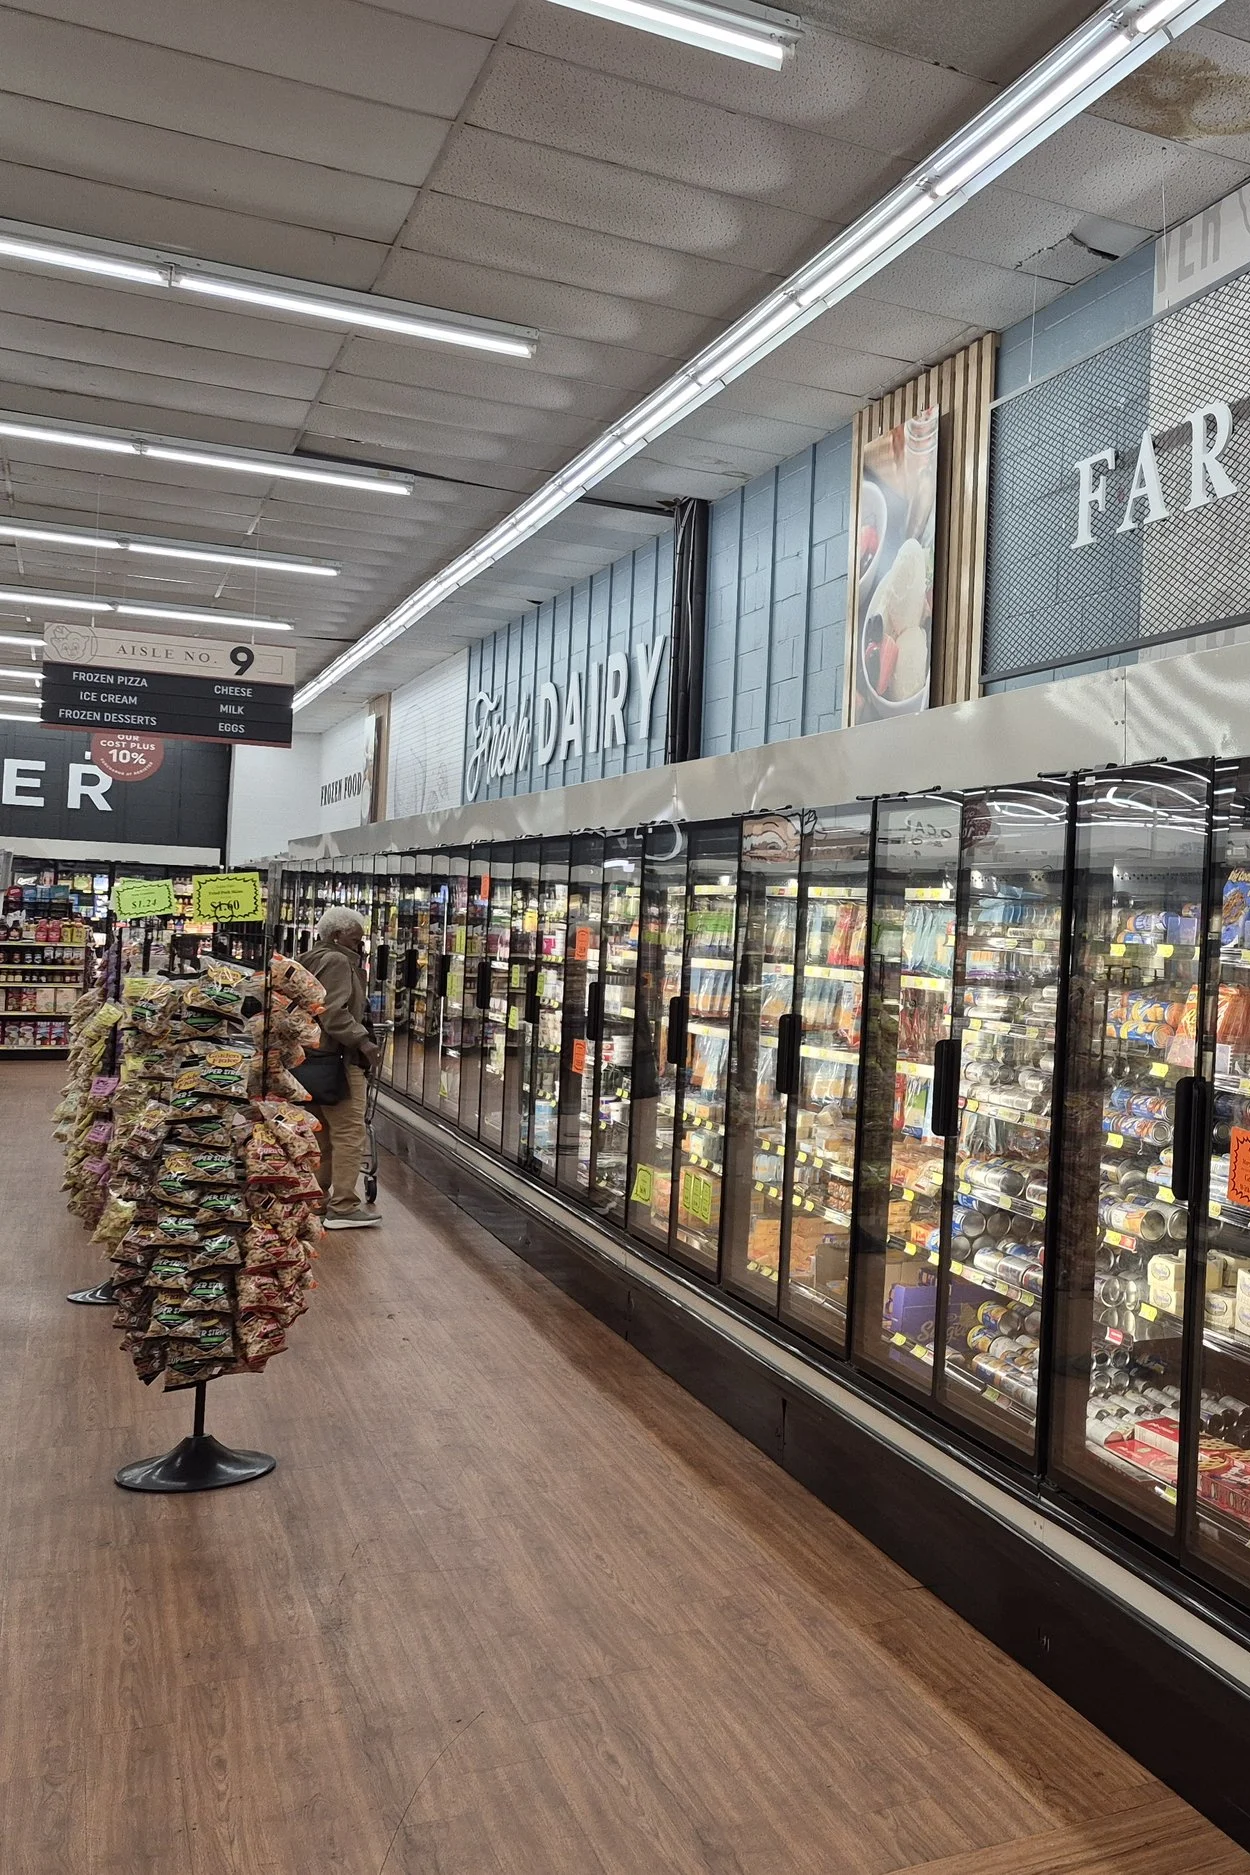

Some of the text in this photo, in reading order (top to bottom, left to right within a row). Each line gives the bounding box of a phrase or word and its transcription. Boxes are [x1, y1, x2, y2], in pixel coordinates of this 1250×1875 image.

[115, 643, 255, 677] AISLE NO. 9
[72, 671, 148, 688] FROZEN PIZZA
[79, 691, 138, 705] ICE CREAM
[214, 685, 253, 698] CHEESE
[58, 708, 158, 726] FROZEN DESSERTS
[219, 704, 245, 716] MILK
[466, 634, 667, 802] Fresh DAIRY
[218, 722, 246, 734] EGGS
[100, 739, 157, 751] COST PLUS
[117, 734, 140, 742] OUR
[108, 749, 147, 765] 10%
[320, 777, 343, 807] FROZEN
